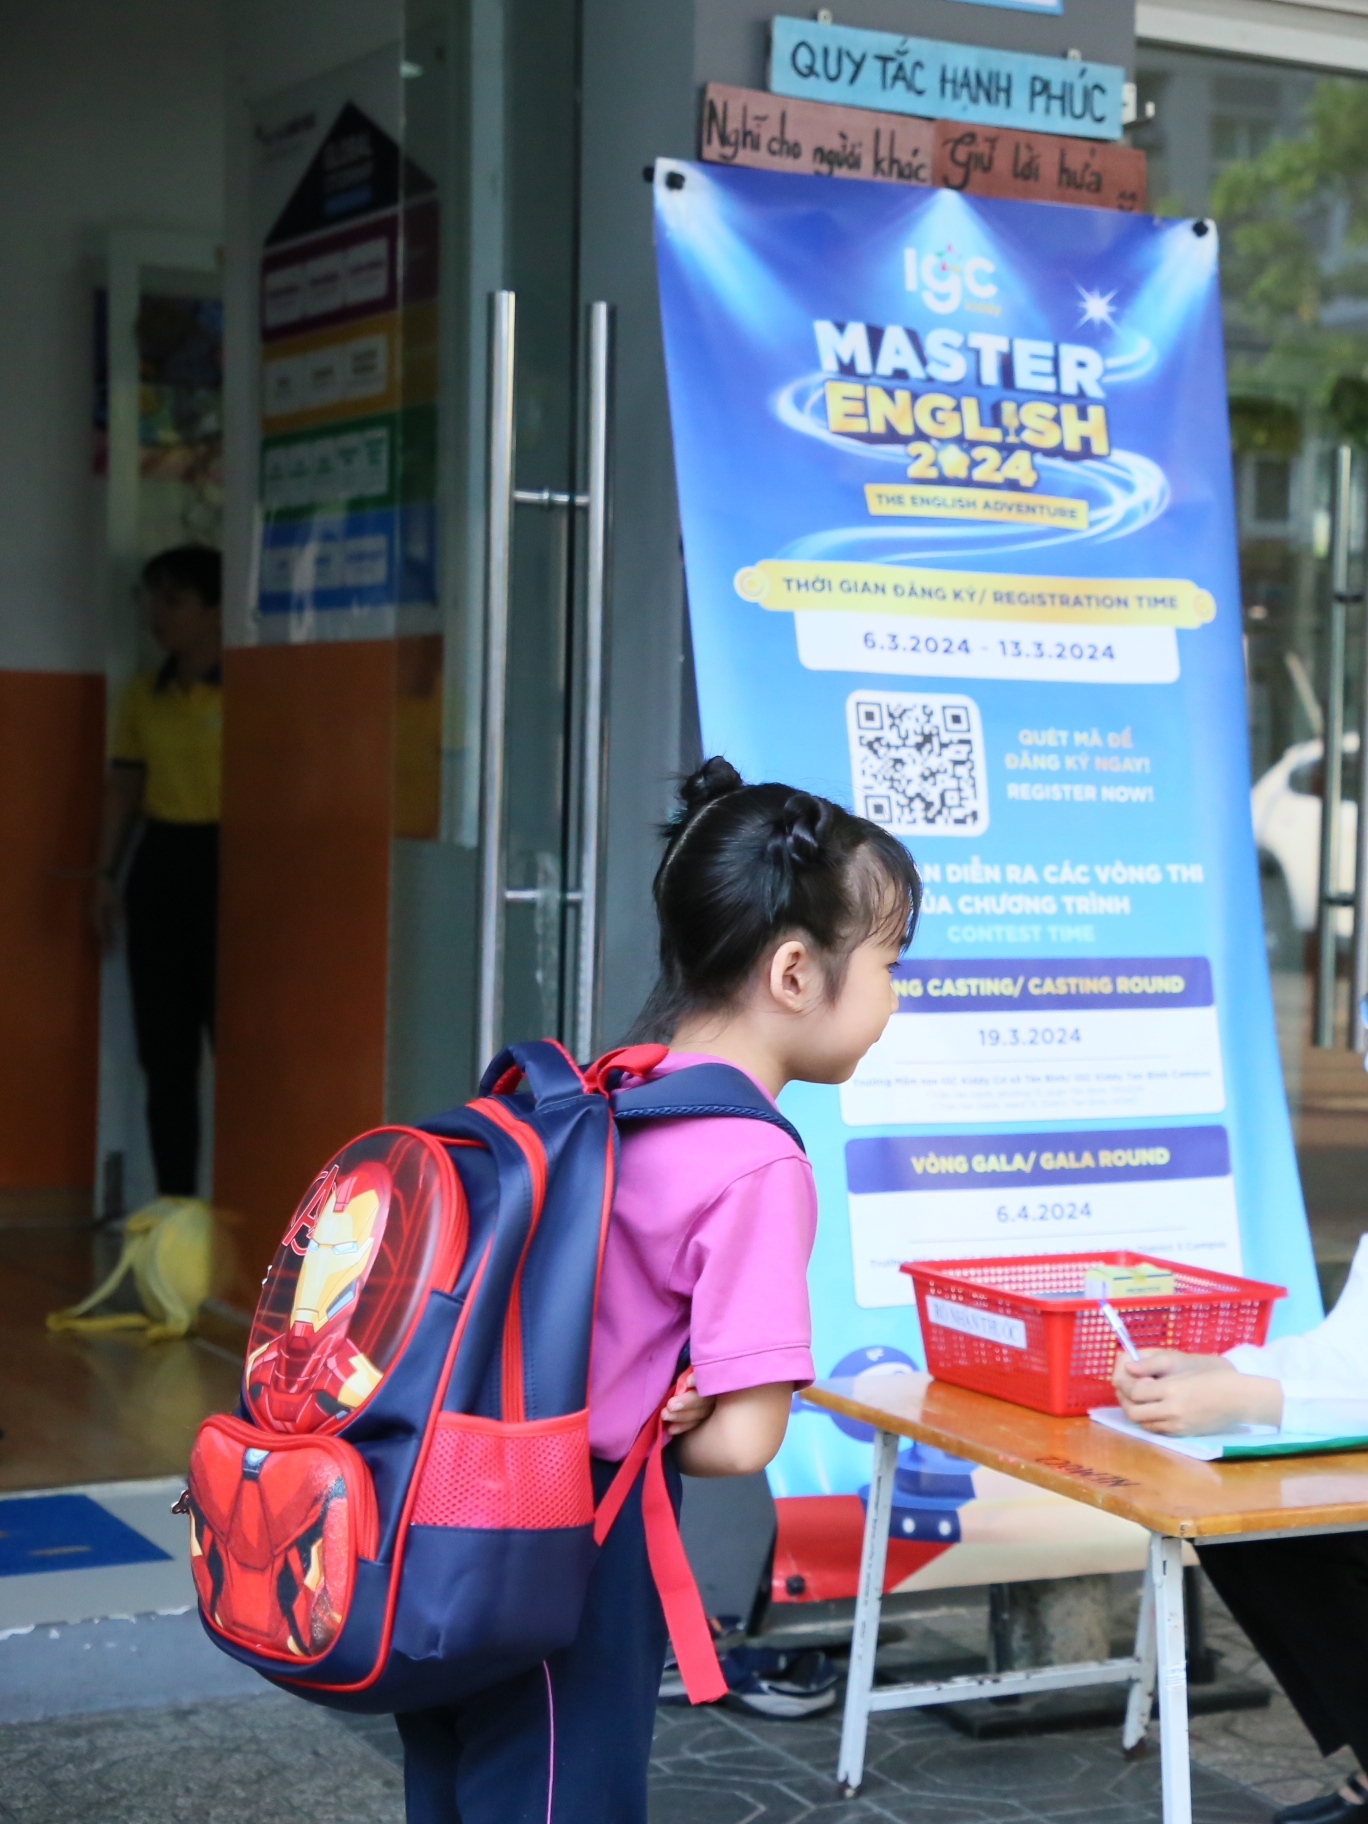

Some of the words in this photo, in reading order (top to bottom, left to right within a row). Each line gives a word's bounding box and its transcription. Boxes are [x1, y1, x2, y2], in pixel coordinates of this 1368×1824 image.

[790, 40, 867, 87] QUY
[875, 39, 926, 96] TẮC
[939, 64, 1012, 111] HẠNH
[1029, 67, 1107, 123] PHÚC
[706, 100, 769, 162] Nghĩ
[767, 110, 801, 160] cho
[813, 132, 862, 176] người
[874, 127, 928, 183] khác
[1012, 142, 1040, 182] lời
[1058, 148, 1103, 193] hứa
[812, 319, 1107, 398] MASTER
[824, 381, 1110, 456] ENGLISH
[876, 492, 905, 508] THE
[910, 494, 979, 511] ENGLISH
[982, 499, 1078, 520] ADVENTURE
[782, 574, 832, 594] THỜI
[838, 579, 887, 596] GIAN
[893, 581, 947, 602] ĐĂNG
[993, 590, 1129, 610] REGISTRATION
[1135, 594, 1179, 611] TIME
[863, 631, 971, 656] 6.3.2024
[998, 638, 1116, 662] 13.3.2024
[1018, 727, 1069, 747] QUÉT
[1065, 752, 1090, 771] KÝ
[1095, 755, 1151, 773] NGAY!
[1006, 782, 1098, 801] REGISTER
[1101, 785, 1154, 803] NOW!
[945, 854, 1001, 884] DIỄN
[1006, 863, 1039, 884] RA
[1043, 860, 1091, 884] CÁC
[1094, 860, 1163, 884] VÒNG
[1166, 863, 1204, 884] THI
[921, 887, 954, 915] ỦA
[957, 893, 1058, 915] CHƯƠNG
[1061, 890, 1132, 915] TRÌNH
[947, 925, 1042, 943] CONTEST
[1046, 925, 1096, 943] TIME
[890, 977, 924, 998] NG
[926, 975, 1025, 998] CASTING/
[1027, 976, 1113, 996] CASTING
[1116, 974, 1186, 995] ROUND
[978, 1027, 1083, 1047] 19.3.2024
[910, 1151, 969, 1175] VÒNG
[971, 1151, 1037, 1174] GALA/
[1039, 1151, 1097, 1171] GALA
[1099, 1147, 1171, 1168] ROUND
[996, 1202, 1093, 1223] 6.4.2024
